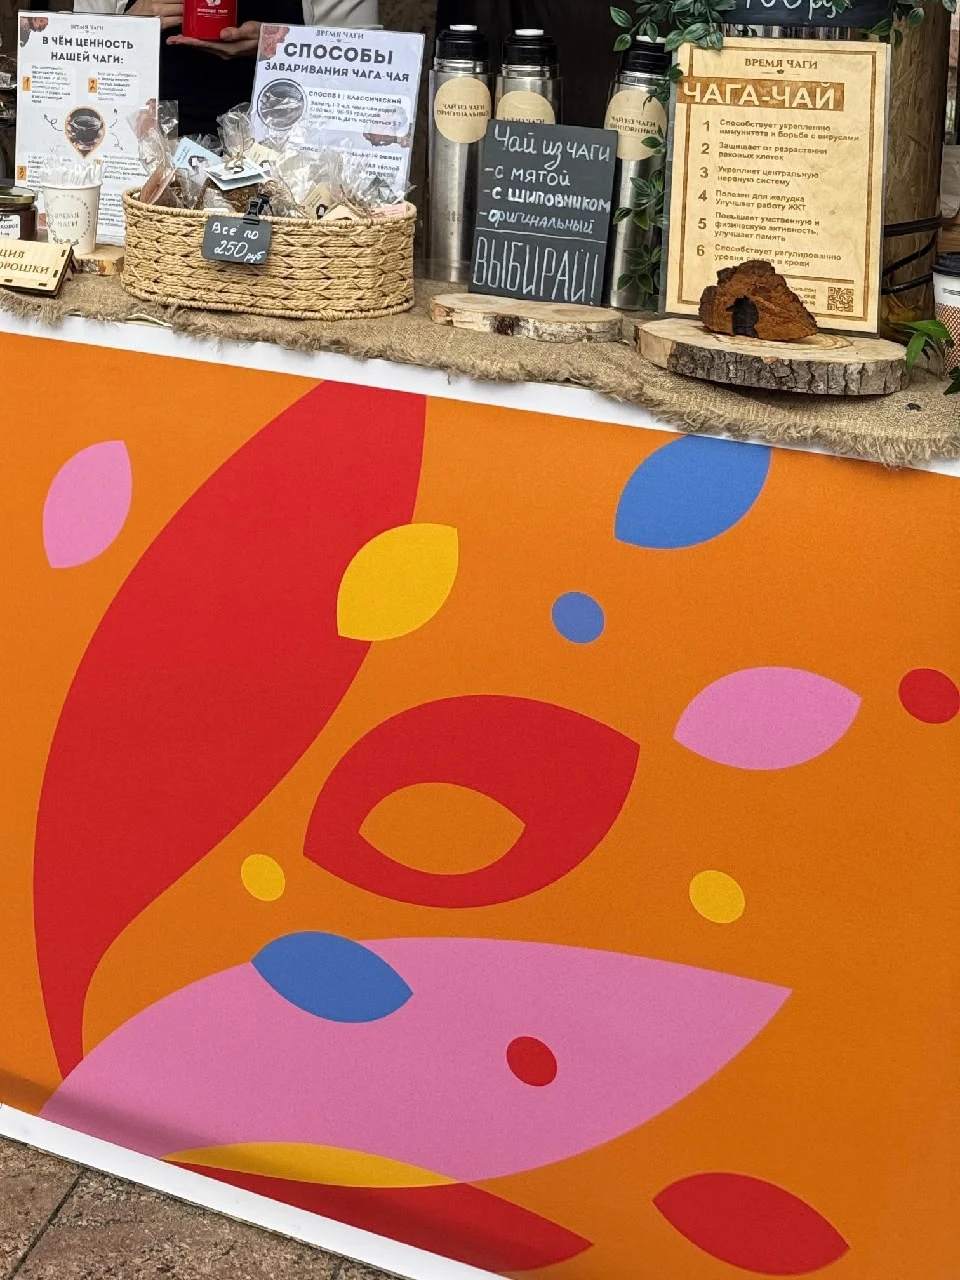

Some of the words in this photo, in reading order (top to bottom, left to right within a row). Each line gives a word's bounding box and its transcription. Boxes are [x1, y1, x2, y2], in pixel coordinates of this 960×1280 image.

[42, 36, 49, 45] В
[51, 35, 73, 47] ЧЁМ
[75, 37, 134, 50] ЦЕННОСТЬ
[51, 50, 90, 63] НАШЕЙ
[92, 54, 124, 64] ЧАГИ:
[283, 42, 393, 65] СПОСОБЫ
[744, 58, 784, 69] ВРЕМЯ
[786, 59, 818, 70] ЧАГИ
[264, 61, 349, 78] ЗАВАРИВАНИЯ
[352, 67, 410, 83] ЧАГА-ЧАЯ
[683, 82, 835, 110] ЧАГА-ЧАЙ
[703, 120, 710, 132] 1
[494, 123, 537, 153] Чай
[701, 142, 710, 155] 2
[699, 166, 709, 179] 3
[697, 189, 708, 202] 4
[697, 217, 707, 230] 5
[213, 239, 249, 258] 250
[696, 244, 705, 257] 6
[472, 235, 599, 305] ВЫБИРАЙ!
